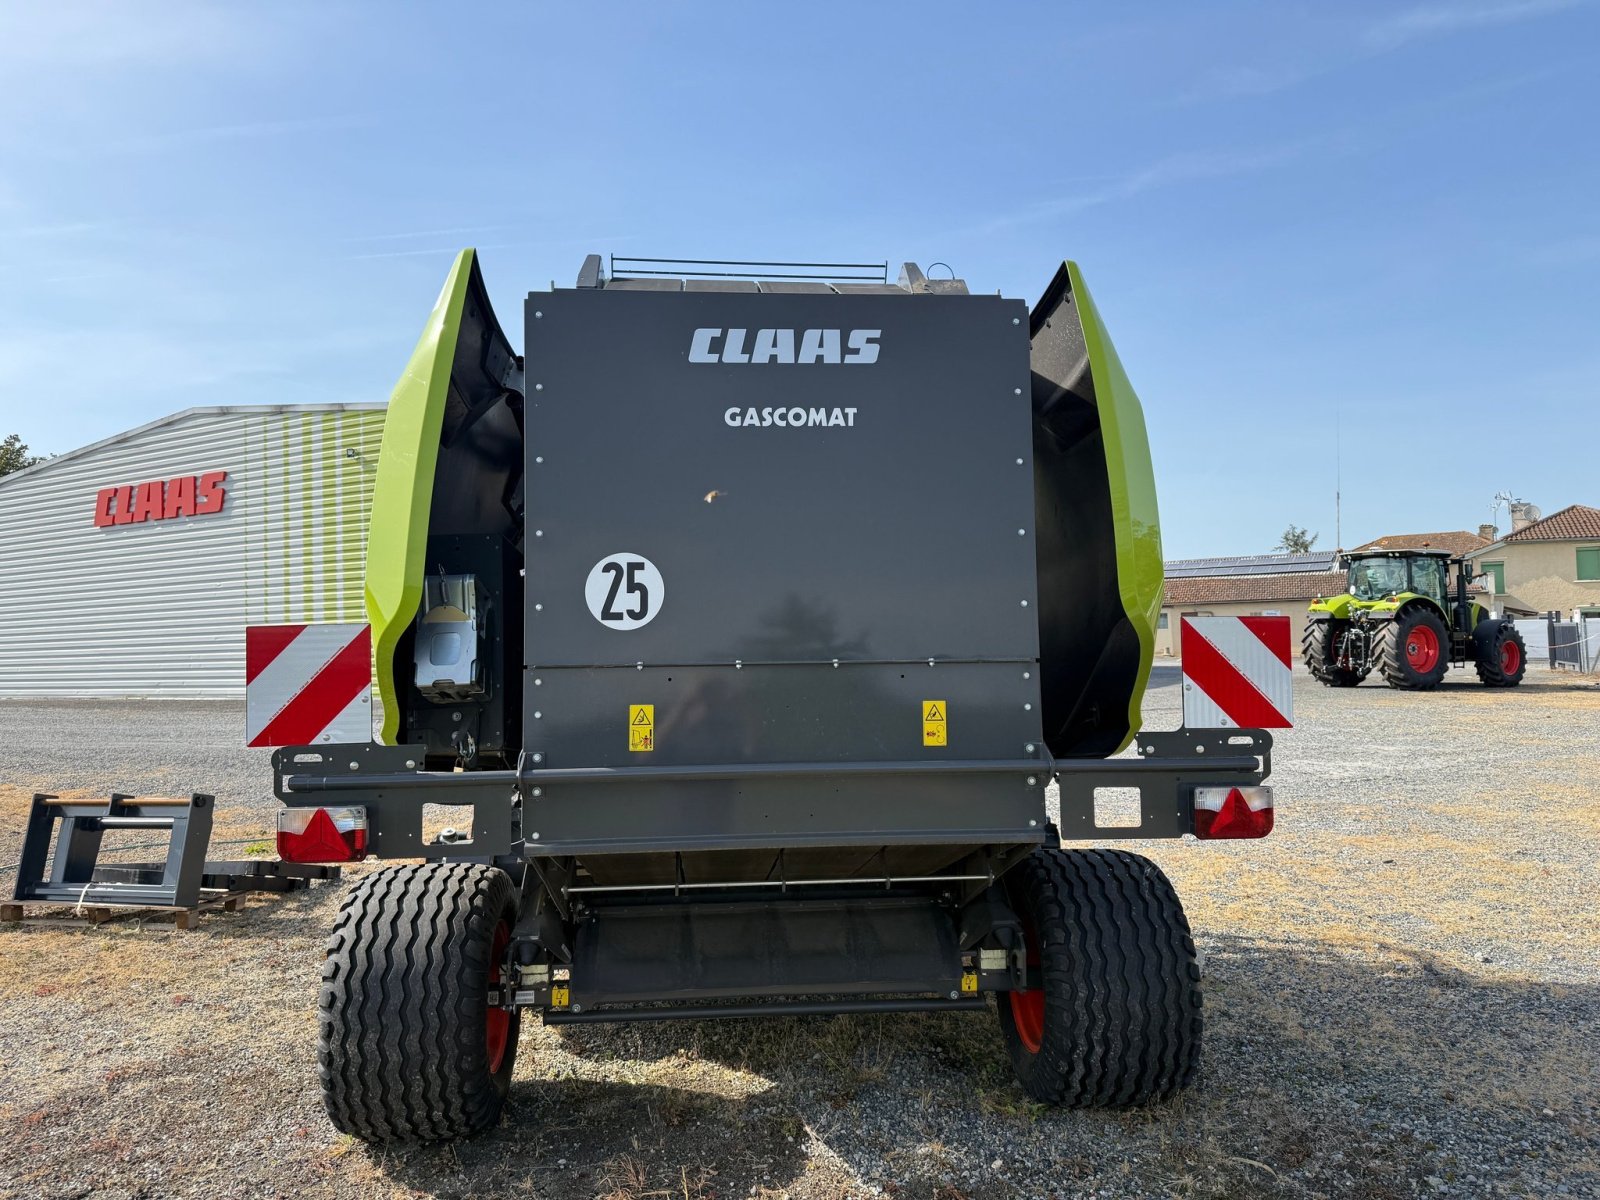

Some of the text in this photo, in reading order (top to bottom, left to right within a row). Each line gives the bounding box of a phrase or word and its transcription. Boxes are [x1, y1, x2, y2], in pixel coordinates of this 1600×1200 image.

[687, 328, 882, 365] CLAAS
[723, 406, 859, 428] GASCOMAT
[94, 471, 227, 528] CLAAS
[600, 561, 650, 621] 25
